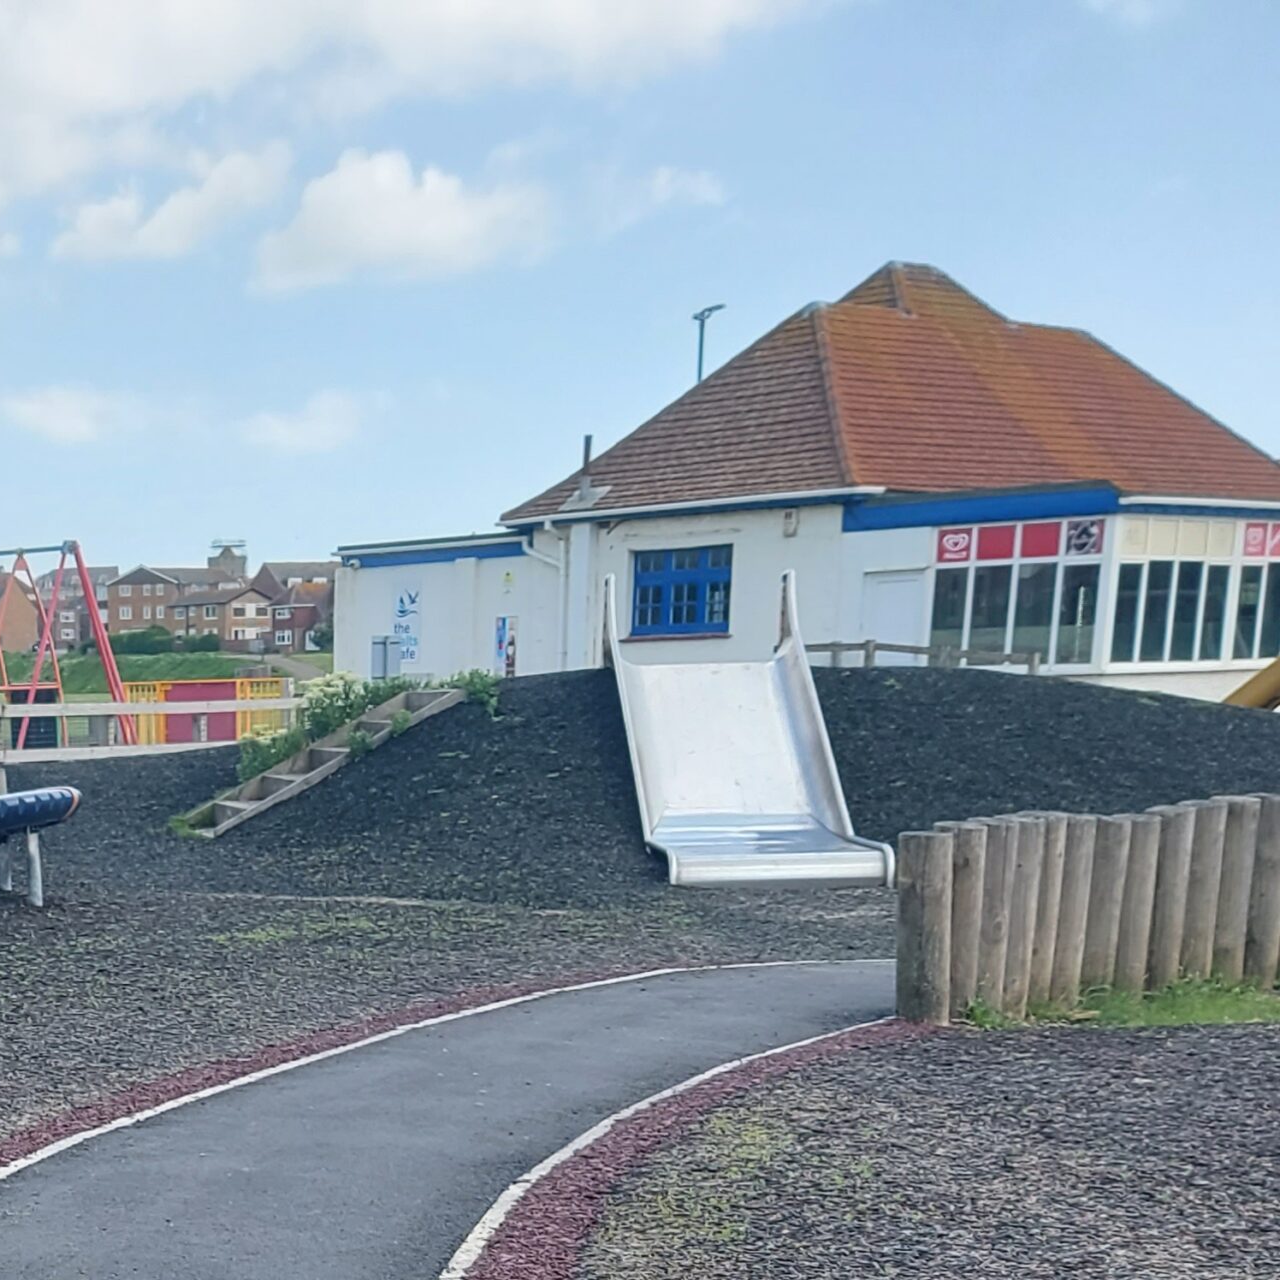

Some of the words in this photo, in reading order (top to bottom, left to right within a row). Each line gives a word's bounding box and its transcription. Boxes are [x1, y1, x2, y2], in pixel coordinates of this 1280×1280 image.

[394, 623, 411, 634] the
[400, 635, 418, 646] alts
[400, 647, 416, 660] afe
